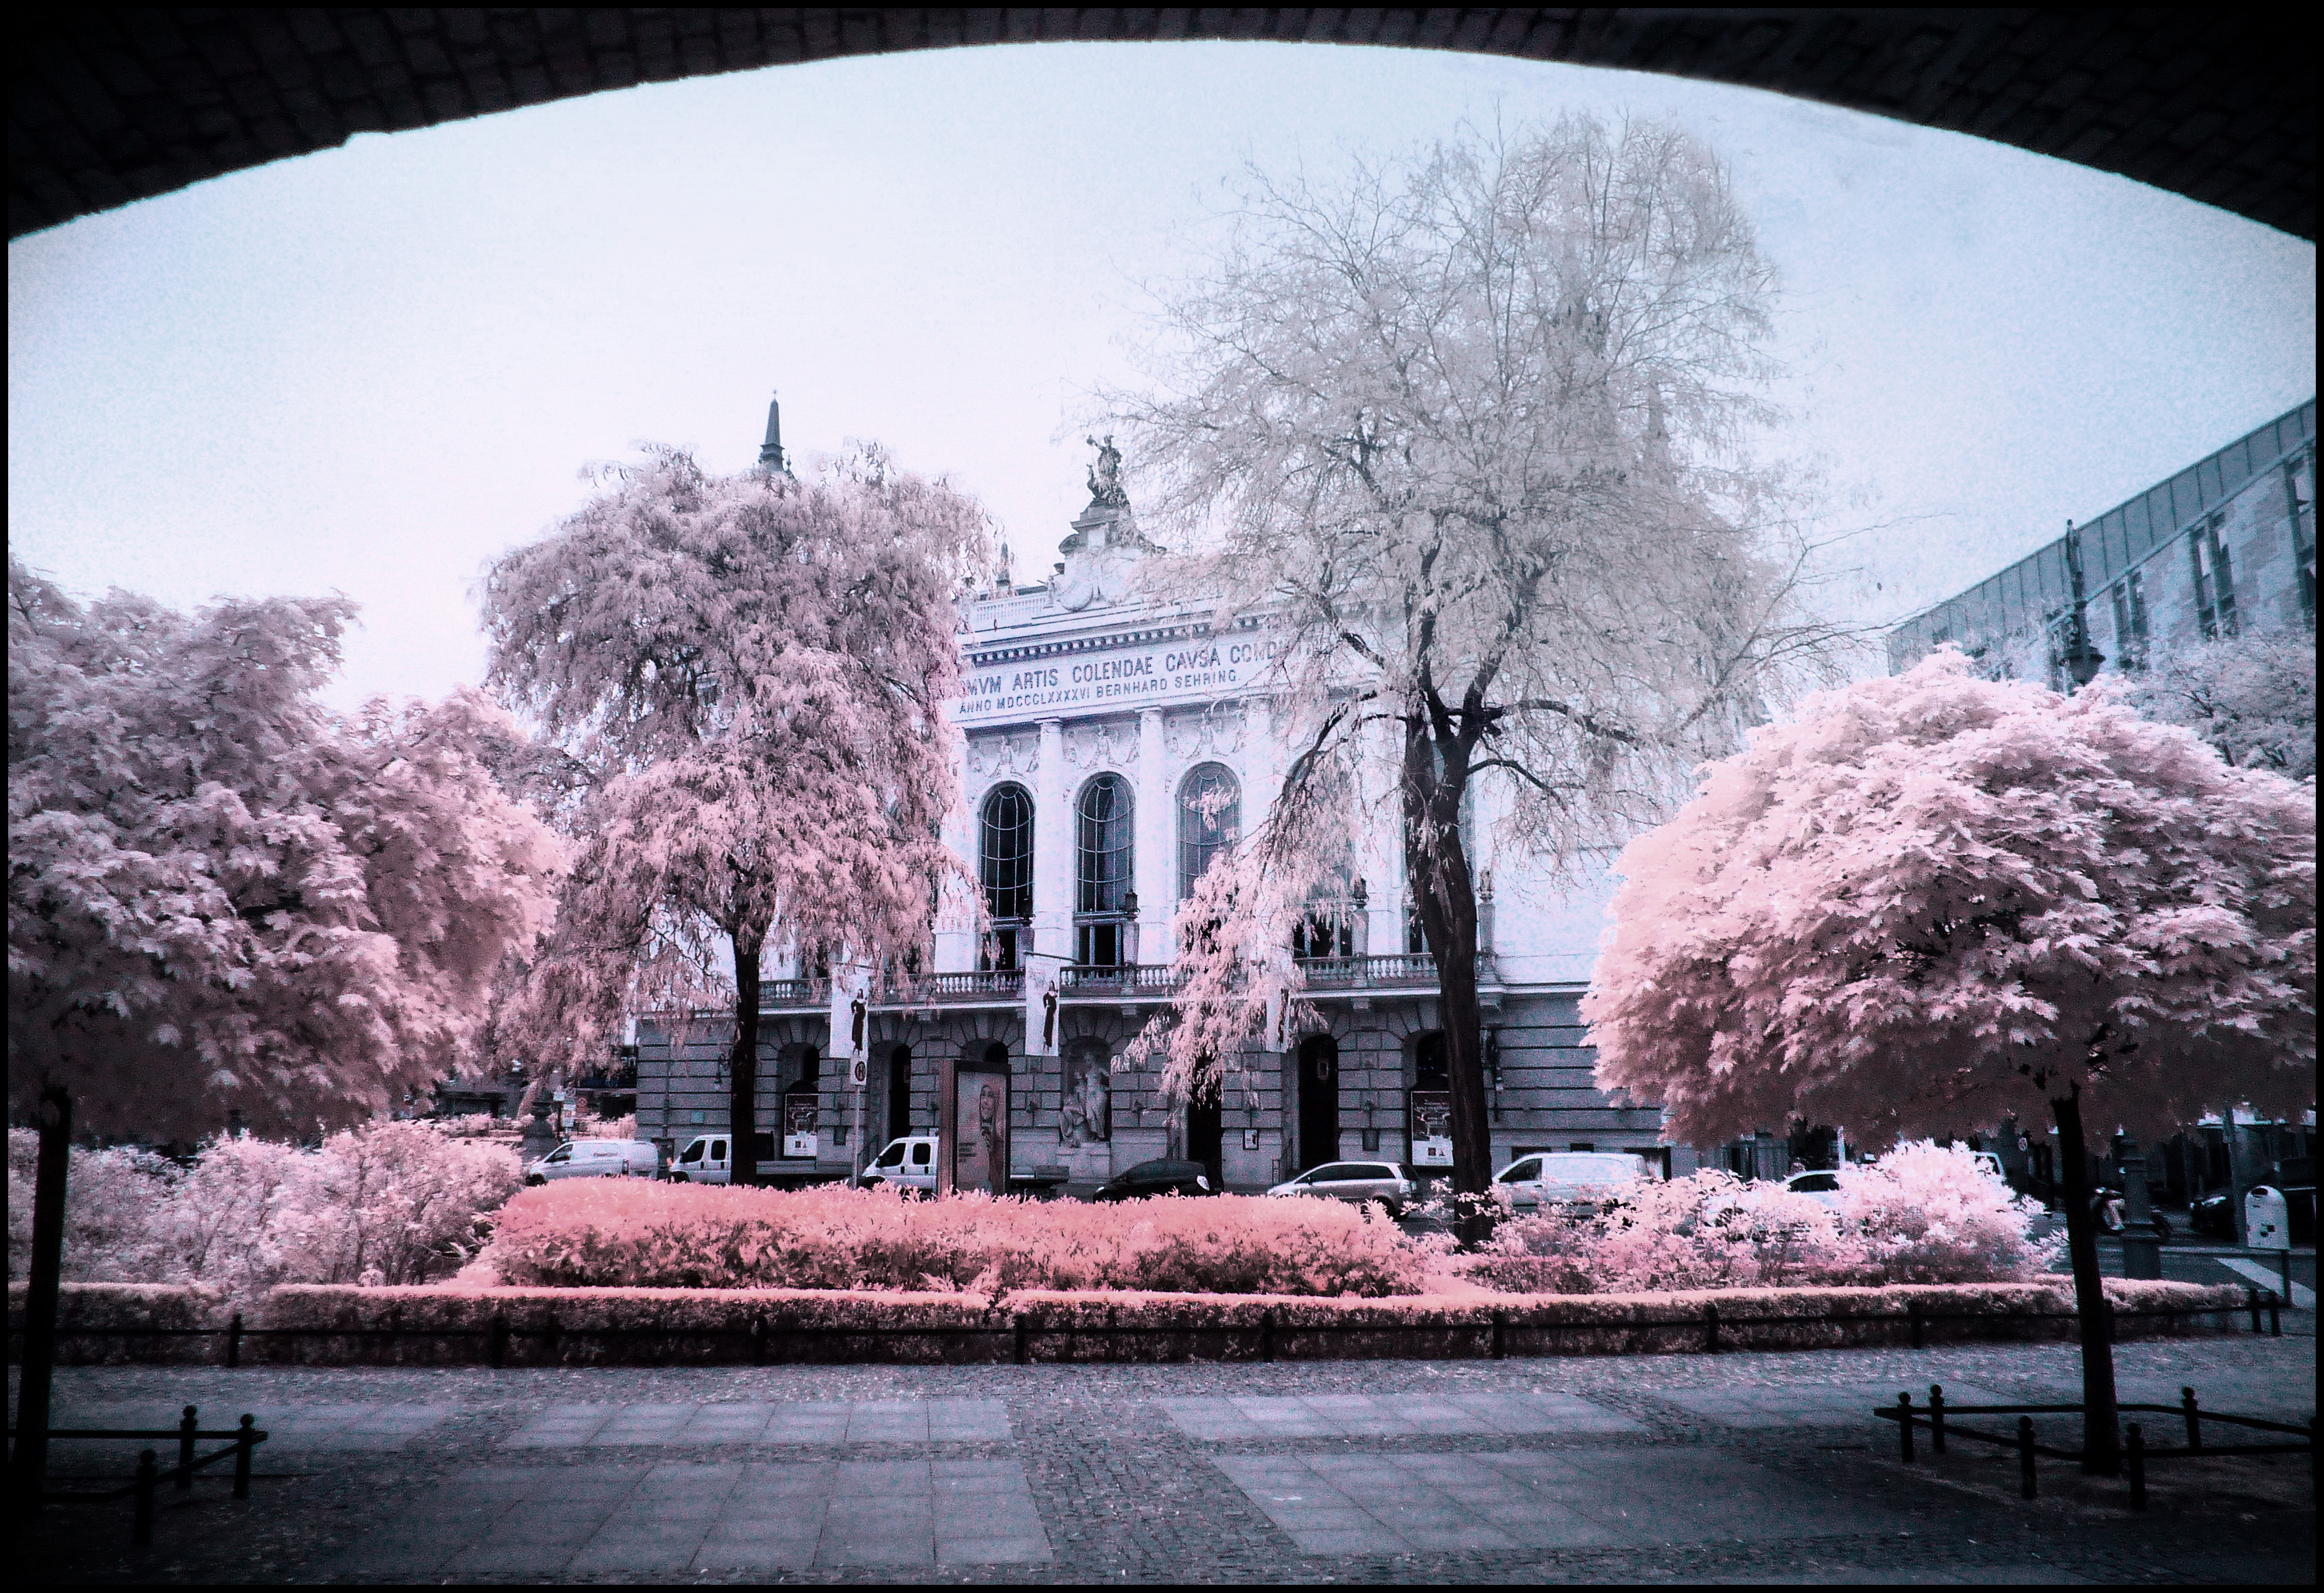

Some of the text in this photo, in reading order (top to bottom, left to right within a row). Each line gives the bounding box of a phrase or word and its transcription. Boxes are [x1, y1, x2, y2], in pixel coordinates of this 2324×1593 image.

[1012, 668, 1059, 691] ARTIS
[1072, 656, 1153, 683] COLENDAE
[1165, 647, 1221, 672] CAVSA
[1230, 641, 1277, 664] COND
[959, 699, 992, 714] ANNO
[997, 687, 1090, 709] MDCCCLXXXXVI
[1096, 678, 1168, 699] BERNHARD
